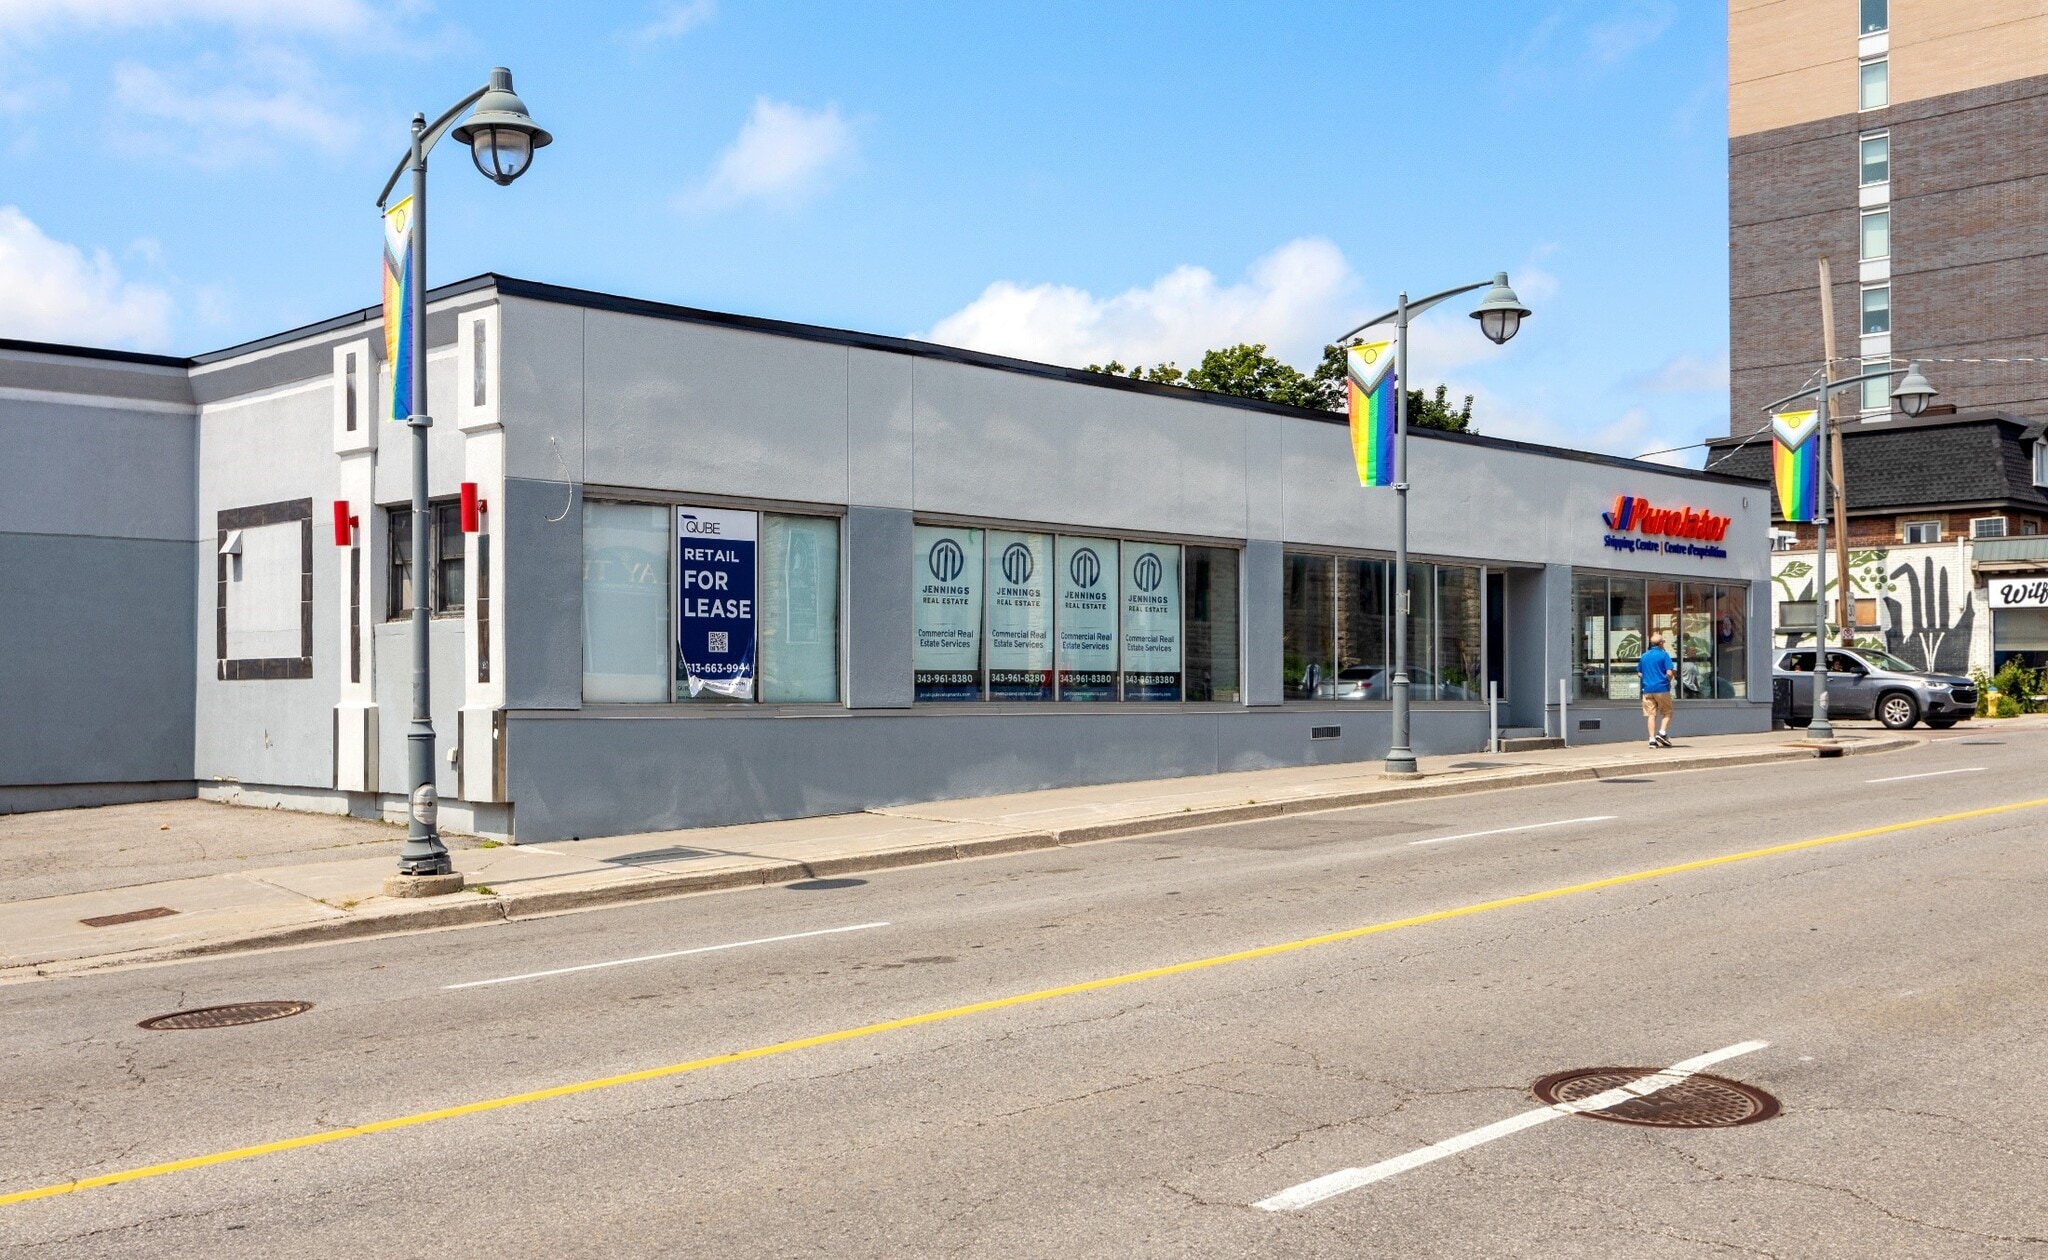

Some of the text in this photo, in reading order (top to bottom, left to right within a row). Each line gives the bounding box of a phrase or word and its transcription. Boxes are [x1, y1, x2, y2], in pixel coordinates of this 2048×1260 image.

[1628, 497, 1731, 541] Purolator
[686, 521, 720, 535] QUBE
[1604, 535, 1635, 553] Shipping
[1636, 538, 1659, 552] Centre
[1664, 541, 1686, 555] Centre
[684, 547, 740, 563] RETAIL
[684, 570, 728, 591] FOR
[922, 585, 970, 595] JENNINGS
[996, 587, 1041, 597] JENNINGS
[1064, 591, 1107, 600] JENNINGS
[1128, 595, 1168, 604] JENNINGS
[942, 597, 969, 605] ESTATE
[684, 598, 751, 619] LEASE
[918, 628, 974, 638] Commercial Real
[991, 629, 1047, 639] Commercial Real
[1060, 631, 1112, 641] Commercial Real
[920, 638, 971, 648] Estate Services
[1125, 634, 1175, 643] Commercial Real
[993, 639, 1044, 649] Estate Services
[1062, 641, 1110, 650] Estate Services
[1127, 644, 1172, 652] Estate Services
[686, 663, 750, 674] 613-663-9944
[916, 674, 973, 683] 343-961-8380
[991, 673, 1046, 683] 343-961-8380
[1059, 674, 1112, 683] 343-961-8380
[1125, 675, 1175, 684] 343-961-8380
